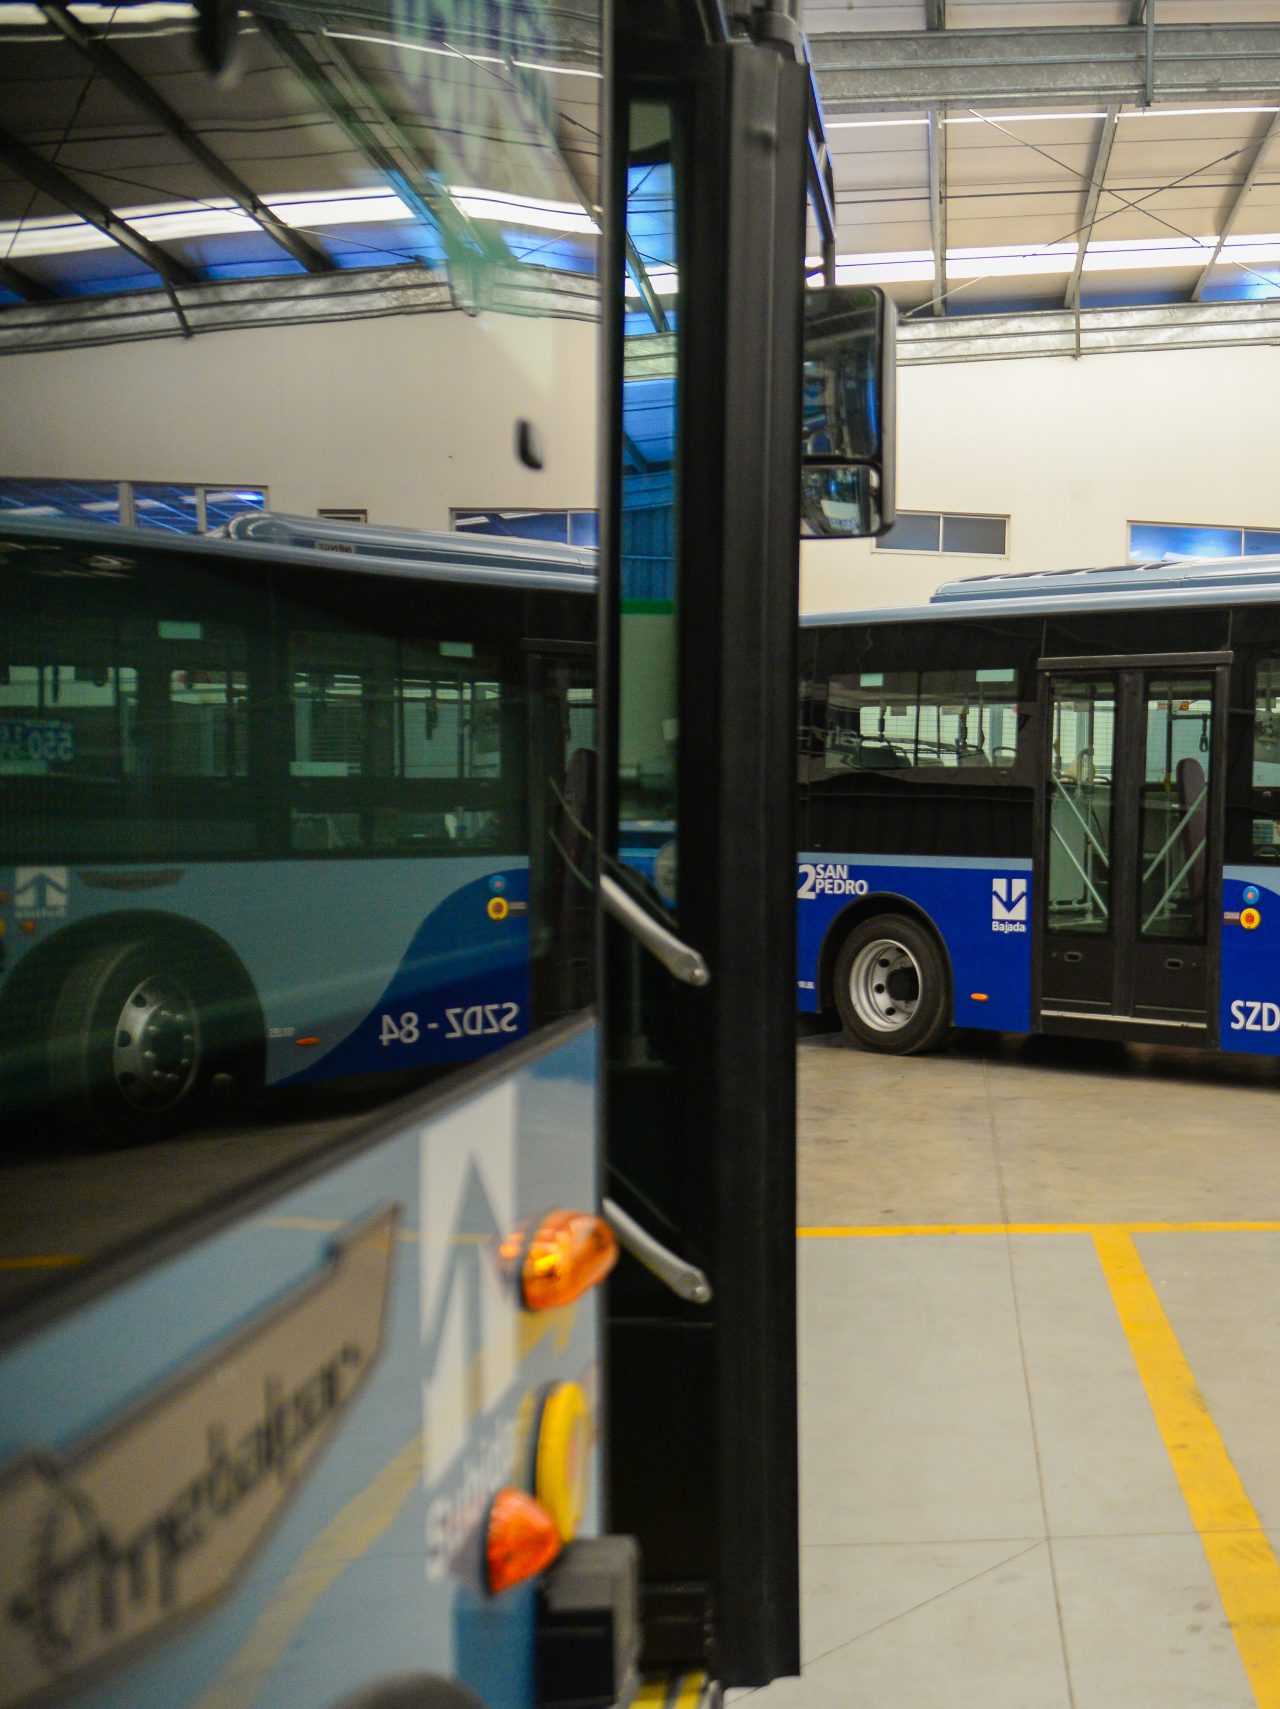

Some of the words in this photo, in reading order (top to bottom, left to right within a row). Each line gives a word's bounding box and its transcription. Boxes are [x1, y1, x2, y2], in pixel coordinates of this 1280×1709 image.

[815, 864, 848, 879] SAN
[815, 879, 868, 895] PEDRO
[992, 921, 1026, 934] Bajada
